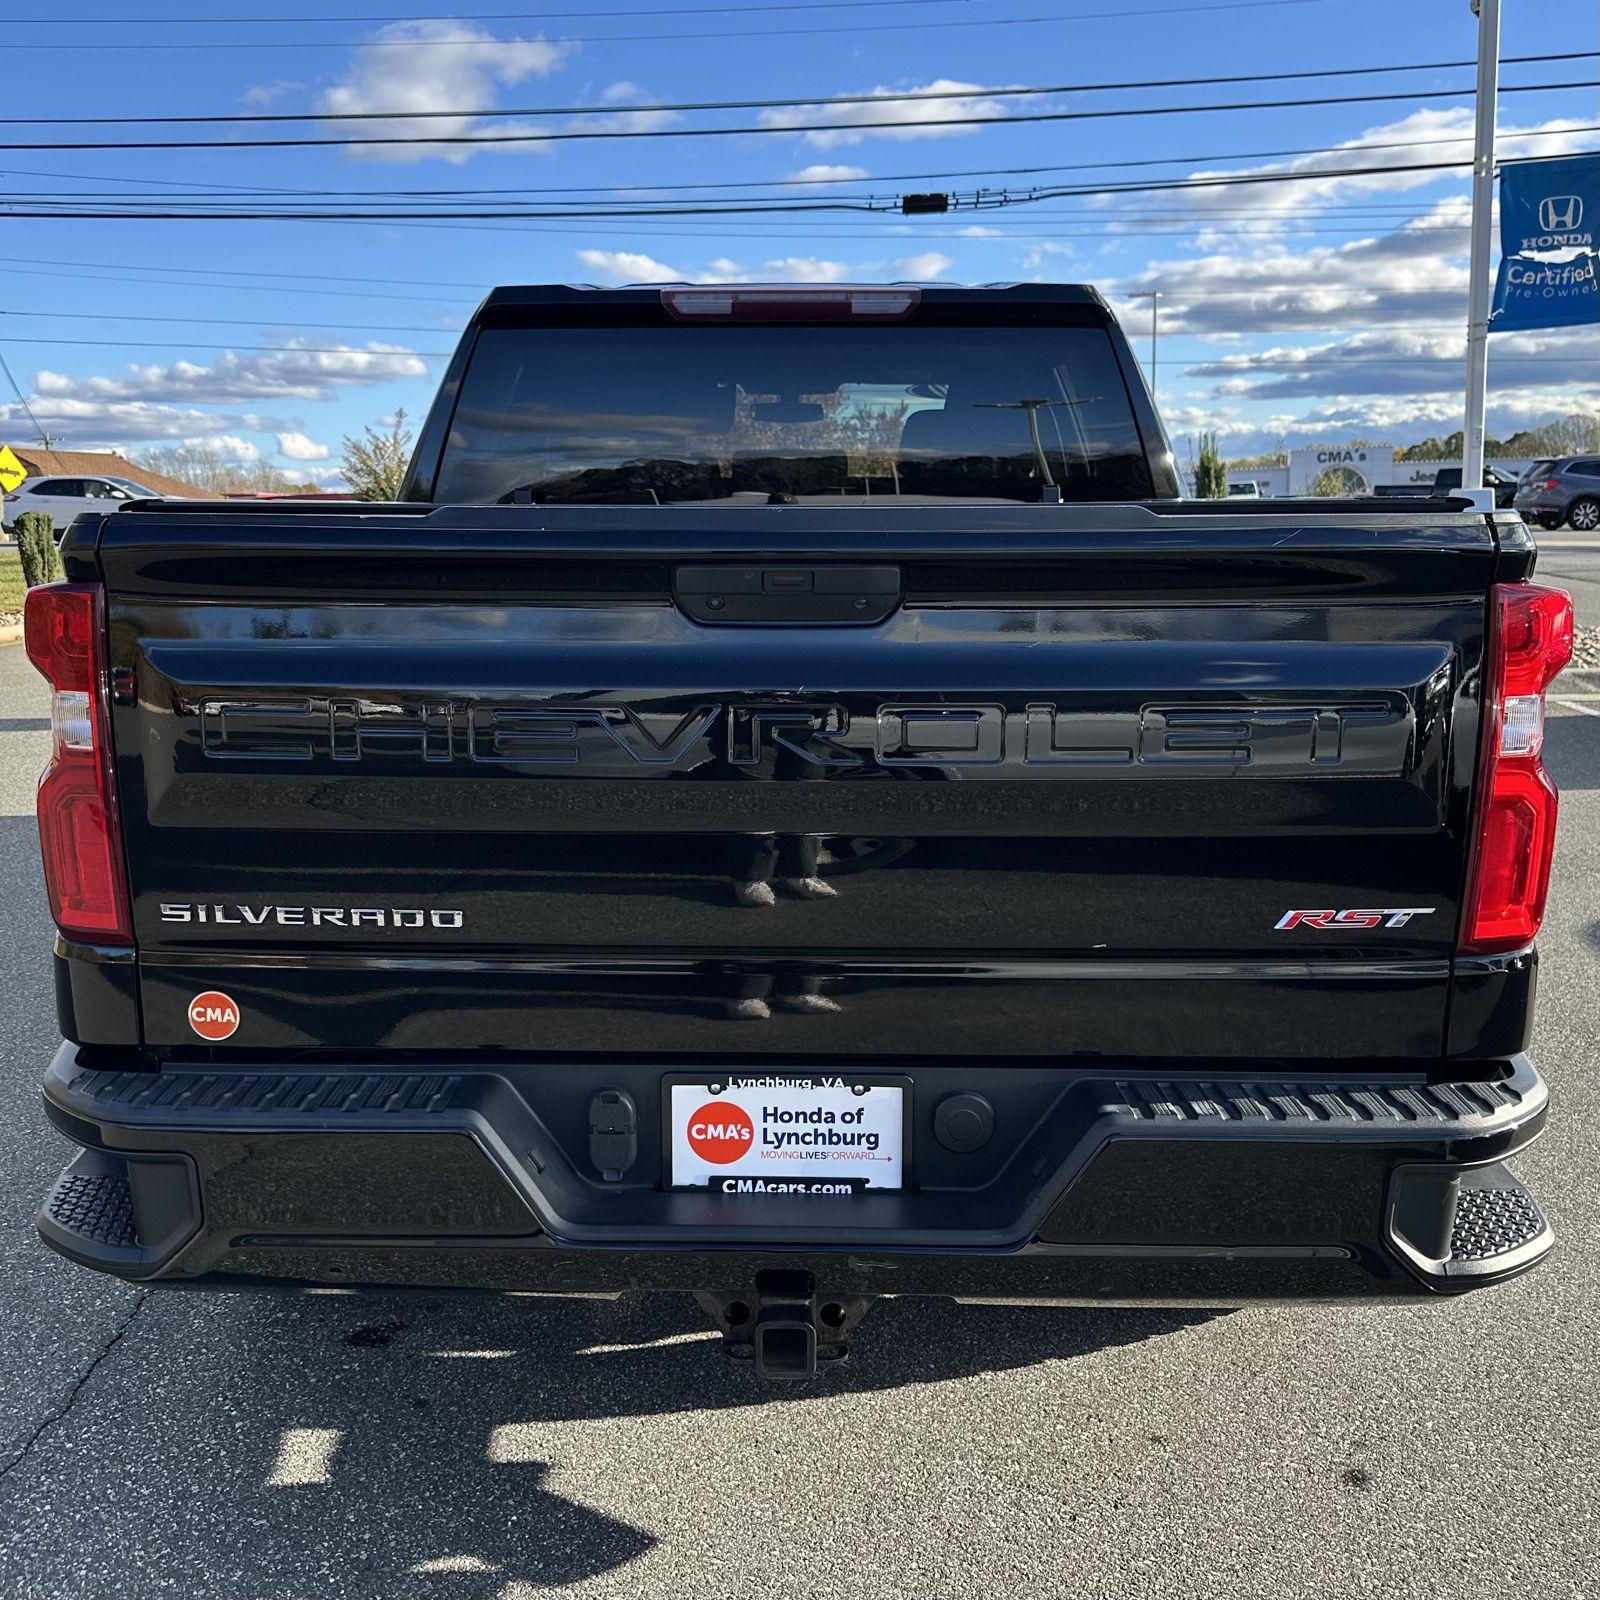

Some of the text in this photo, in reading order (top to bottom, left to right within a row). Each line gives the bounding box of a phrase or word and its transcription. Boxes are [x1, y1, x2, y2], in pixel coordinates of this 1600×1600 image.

[1521, 233, 1592, 250] HONDA
[1507, 259, 1595, 286] Certified
[1505, 280, 1598, 298] Pre-Owned
[1410, 470, 1436, 482] Jee
[201, 696, 1391, 765] CHEVROLET
[160, 903, 463, 928] SILVERADO
[1274, 908, 1436, 930] RST
[192, 1007, 236, 1023] CMA
[728, 1077, 845, 1090] Lynchburg, VA
[762, 1106, 865, 1124] Honda of
[691, 1123, 751, 1140] CMA's
[762, 1128, 880, 1150] Lynchburg
[722, 1179, 852, 1194] CMAcars.com
